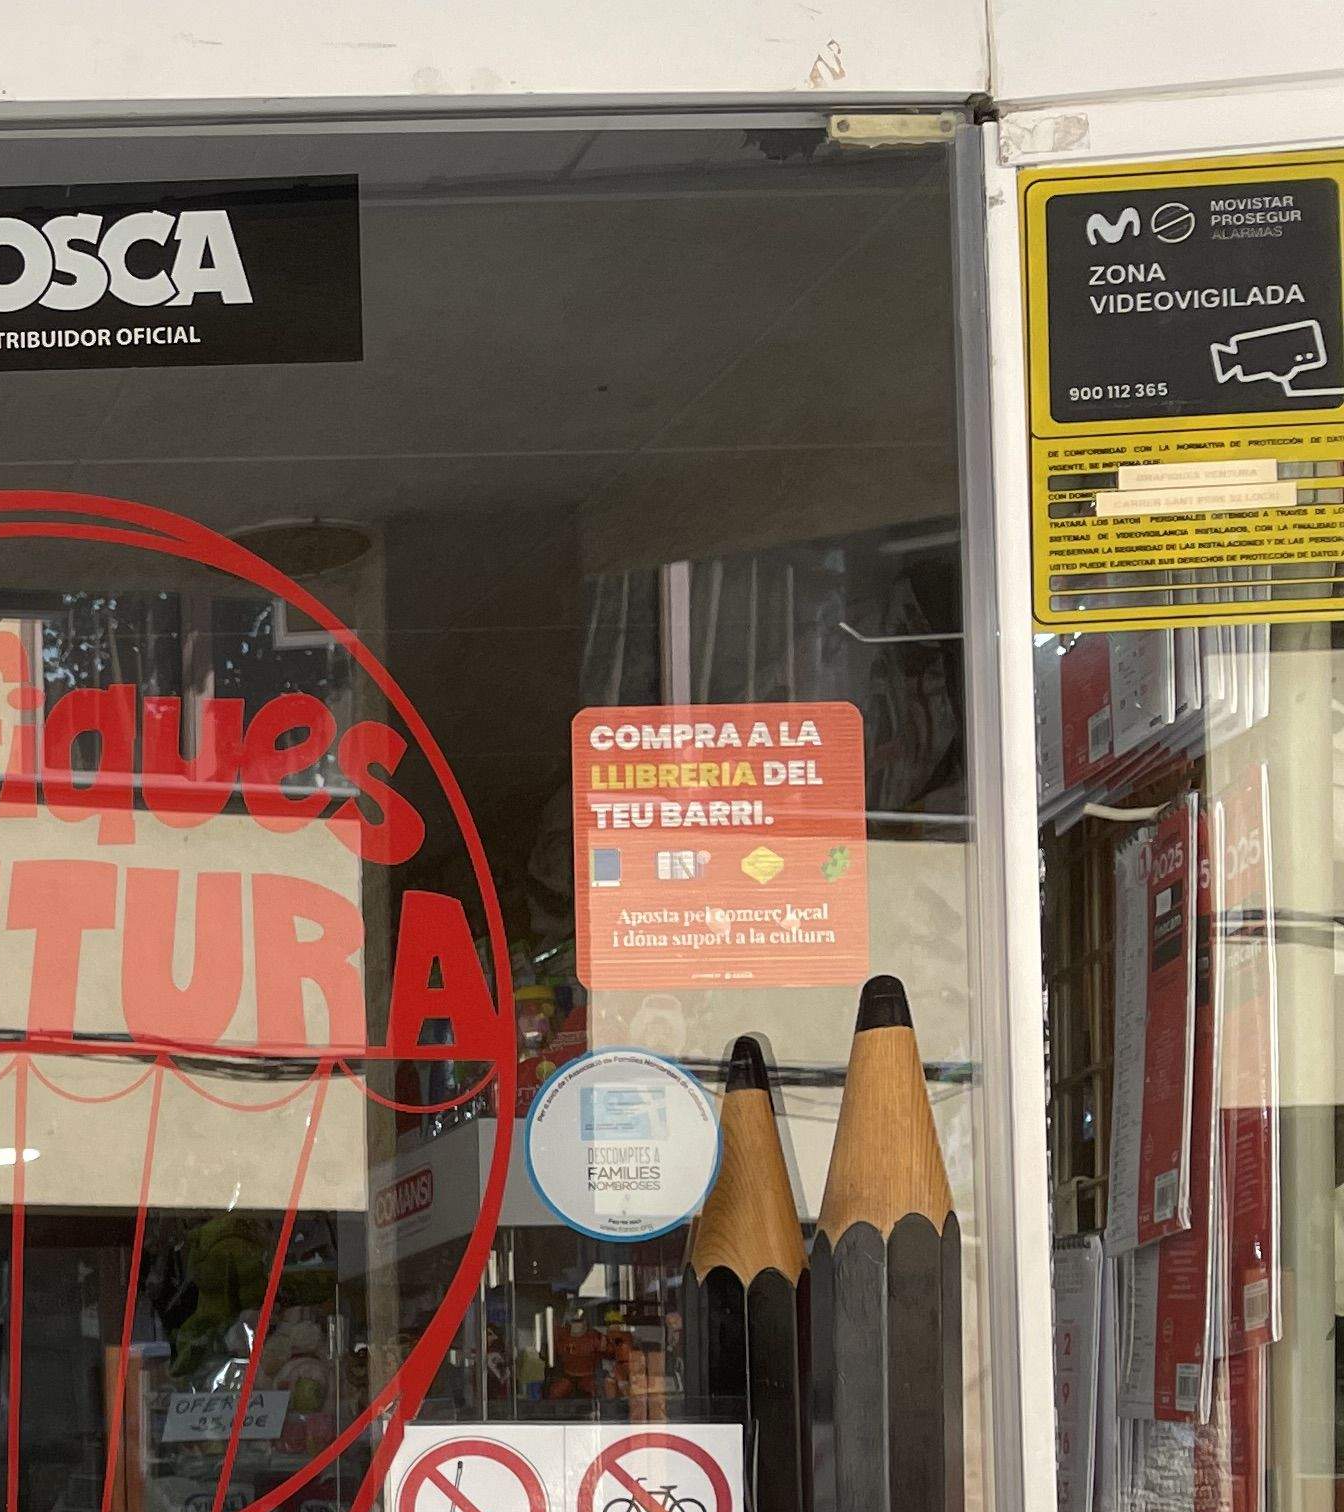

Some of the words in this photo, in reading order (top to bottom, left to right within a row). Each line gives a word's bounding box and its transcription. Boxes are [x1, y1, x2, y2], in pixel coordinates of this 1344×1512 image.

[1210, 196, 1294, 212] MOVISTAR
[1211, 210, 1302, 227] PROSEGUR
[1212, 226, 1283, 241] ALARMAS
[1089, 263, 1166, 286] ZONA
[1090, 284, 1305, 315] VIDEOVIGILADA
[116, 326, 201, 348] OFICIAL
[1069, 386, 1103, 401] 900
[1107, 384, 1131, 399] 112
[1135, 382, 1168, 398] 365
[590, 722, 738, 750] COMPRA
[747, 721, 773, 748] A
[780, 720, 823, 747] LA
[590, 761, 757, 790] LLIBRERIA
[763, 760, 823, 786] DEL
[590, 802, 654, 829] TEU
[660, 800, 774, 827] BARRI.
[618, 907, 679, 927] Aposta
[684, 905, 711, 927] pel
[786, 903, 829, 922] local
[613, 930, 618, 947] i
[623, 929, 668, 948] dóna
[672, 928, 732, 949] suport
[735, 933, 746, 945] a
[750, 928, 765, 945] la
[769, 926, 836, 945] cultura
[588, 1147, 651, 1165] DESCOMPTES
[588, 1166, 661, 1180] FAMILIES
[588, 1181, 661, 1191] NOMBROSES
[175, 1392, 265, 1416] OFERA
